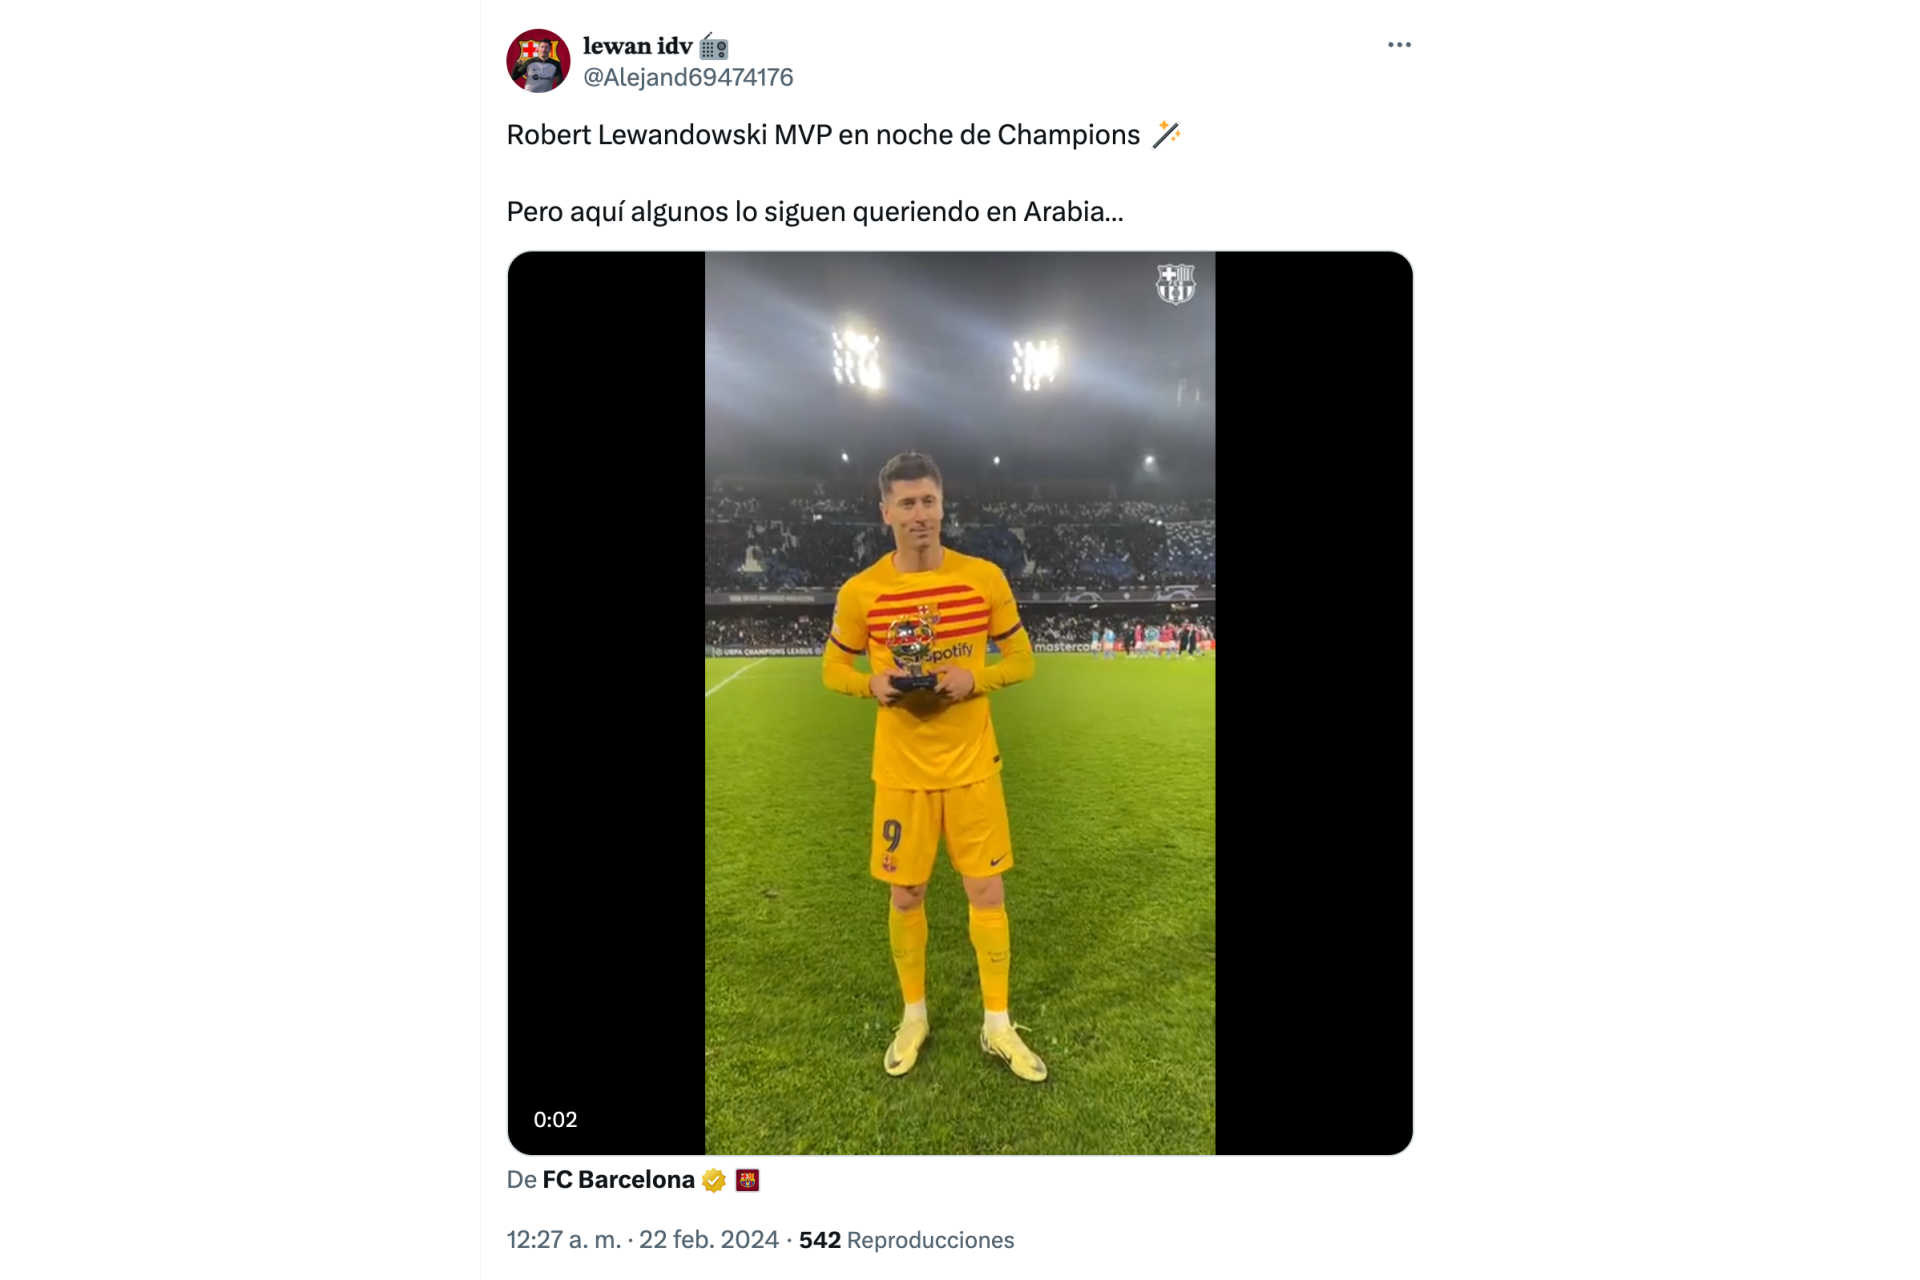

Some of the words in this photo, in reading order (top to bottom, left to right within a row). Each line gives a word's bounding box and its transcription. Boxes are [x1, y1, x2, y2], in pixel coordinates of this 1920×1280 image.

[583, 36, 652, 55] lewan
[657, 36, 693, 55] idv
[584, 67, 794, 91] @Alejand69474176
[508, 123, 591, 145] Robert
[600, 123, 766, 145] Lewandowski
[776, 124, 832, 145] MVP
[839, 129, 868, 145] en
[878, 123, 953, 145] noche
[960, 123, 991, 145] de
[999, 123, 1140, 150] Champions
[508, 201, 563, 222] Pero
[571, 200, 626, 227] aquí
[632, 200, 728, 227] algunos
[737, 200, 757, 222] lo
[765, 200, 845, 227] siguen
[853, 200, 979, 227] queriendo
[987, 206, 1016, 222] en
[724, 648, 743, 656] UEFA
[744, 647, 786, 656] CHAMPIONS
[787, 647, 813, 656] LEAGUE
[882, 819, 902, 852] 9
[534, 1111, 577, 1128] 0:02
[508, 1170, 537, 1189] De
[544, 1170, 573, 1189] FC
[579, 1169, 695, 1189] Barcelona
[507, 1230, 563, 1249] 12:27
[640, 1230, 666, 1249] 22
[673, 1229, 714, 1249] feb.
[722, 1230, 779, 1249] 2024
[800, 1231, 841, 1249] 542
[848, 1230, 1014, 1253] Reproducciones
